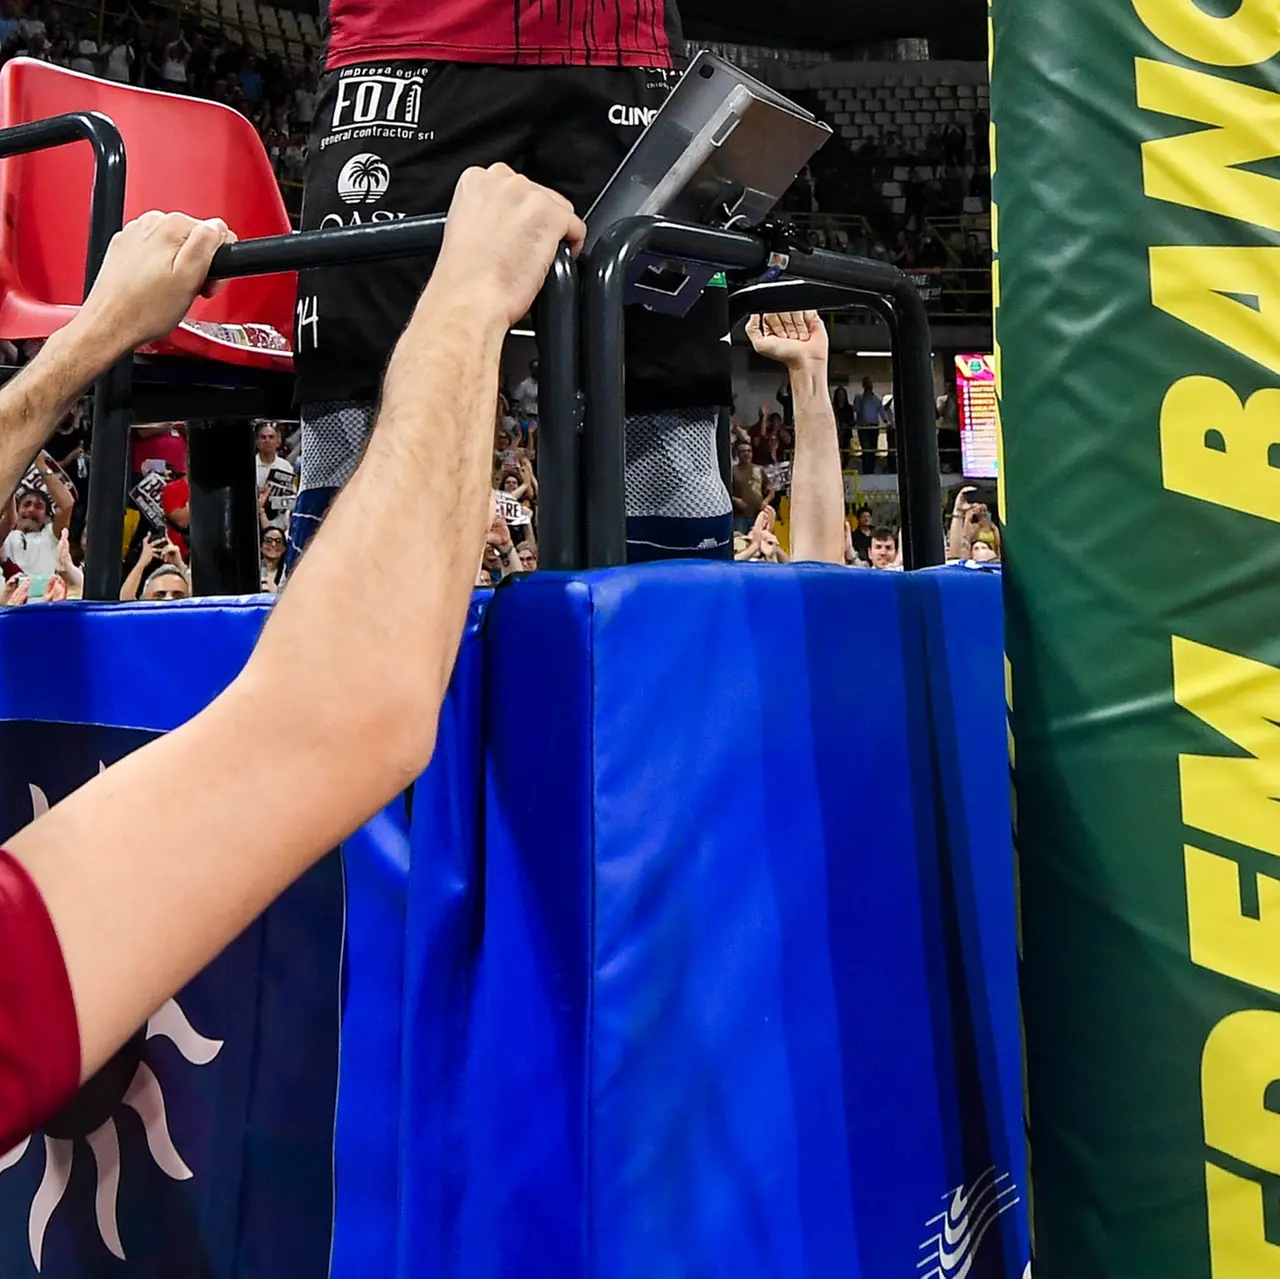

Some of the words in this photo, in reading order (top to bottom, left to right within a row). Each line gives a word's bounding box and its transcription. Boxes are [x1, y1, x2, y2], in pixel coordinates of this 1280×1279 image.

[319, 128, 352, 151] general
[352, 126, 415, 140] contractor
[417, 130, 435, 141] srl
[296, 294, 320, 353] 14
